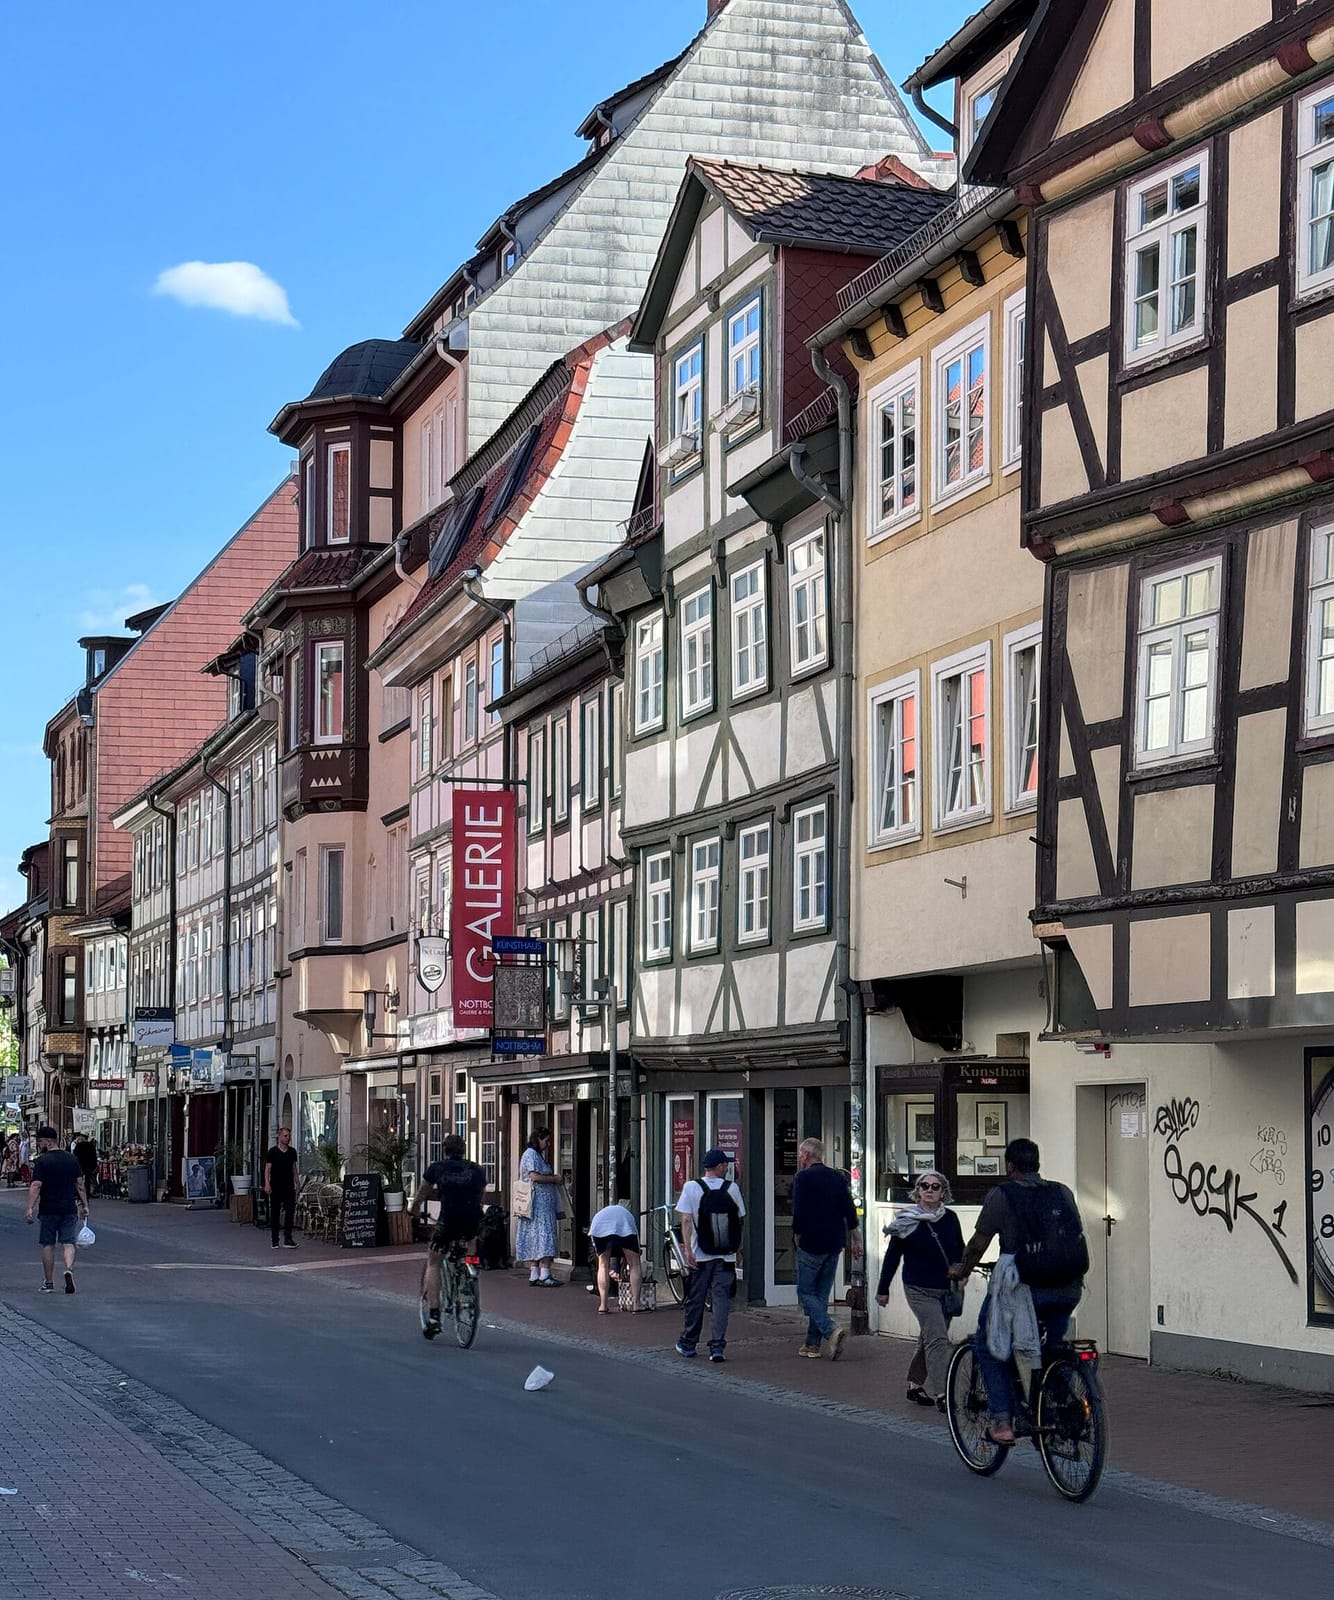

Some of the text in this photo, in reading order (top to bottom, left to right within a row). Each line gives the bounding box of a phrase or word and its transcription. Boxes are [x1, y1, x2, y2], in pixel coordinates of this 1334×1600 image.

[464, 805, 503, 982] GALERIE
[496, 939, 542, 950] KUNSTHAUS
[496, 1041, 541, 1051] NOTTBOHM
[1318, 1124, 1331, 1147] 10
[1311, 1169, 1324, 1192] 9
[1320, 1214, 1334, 1238] 8
